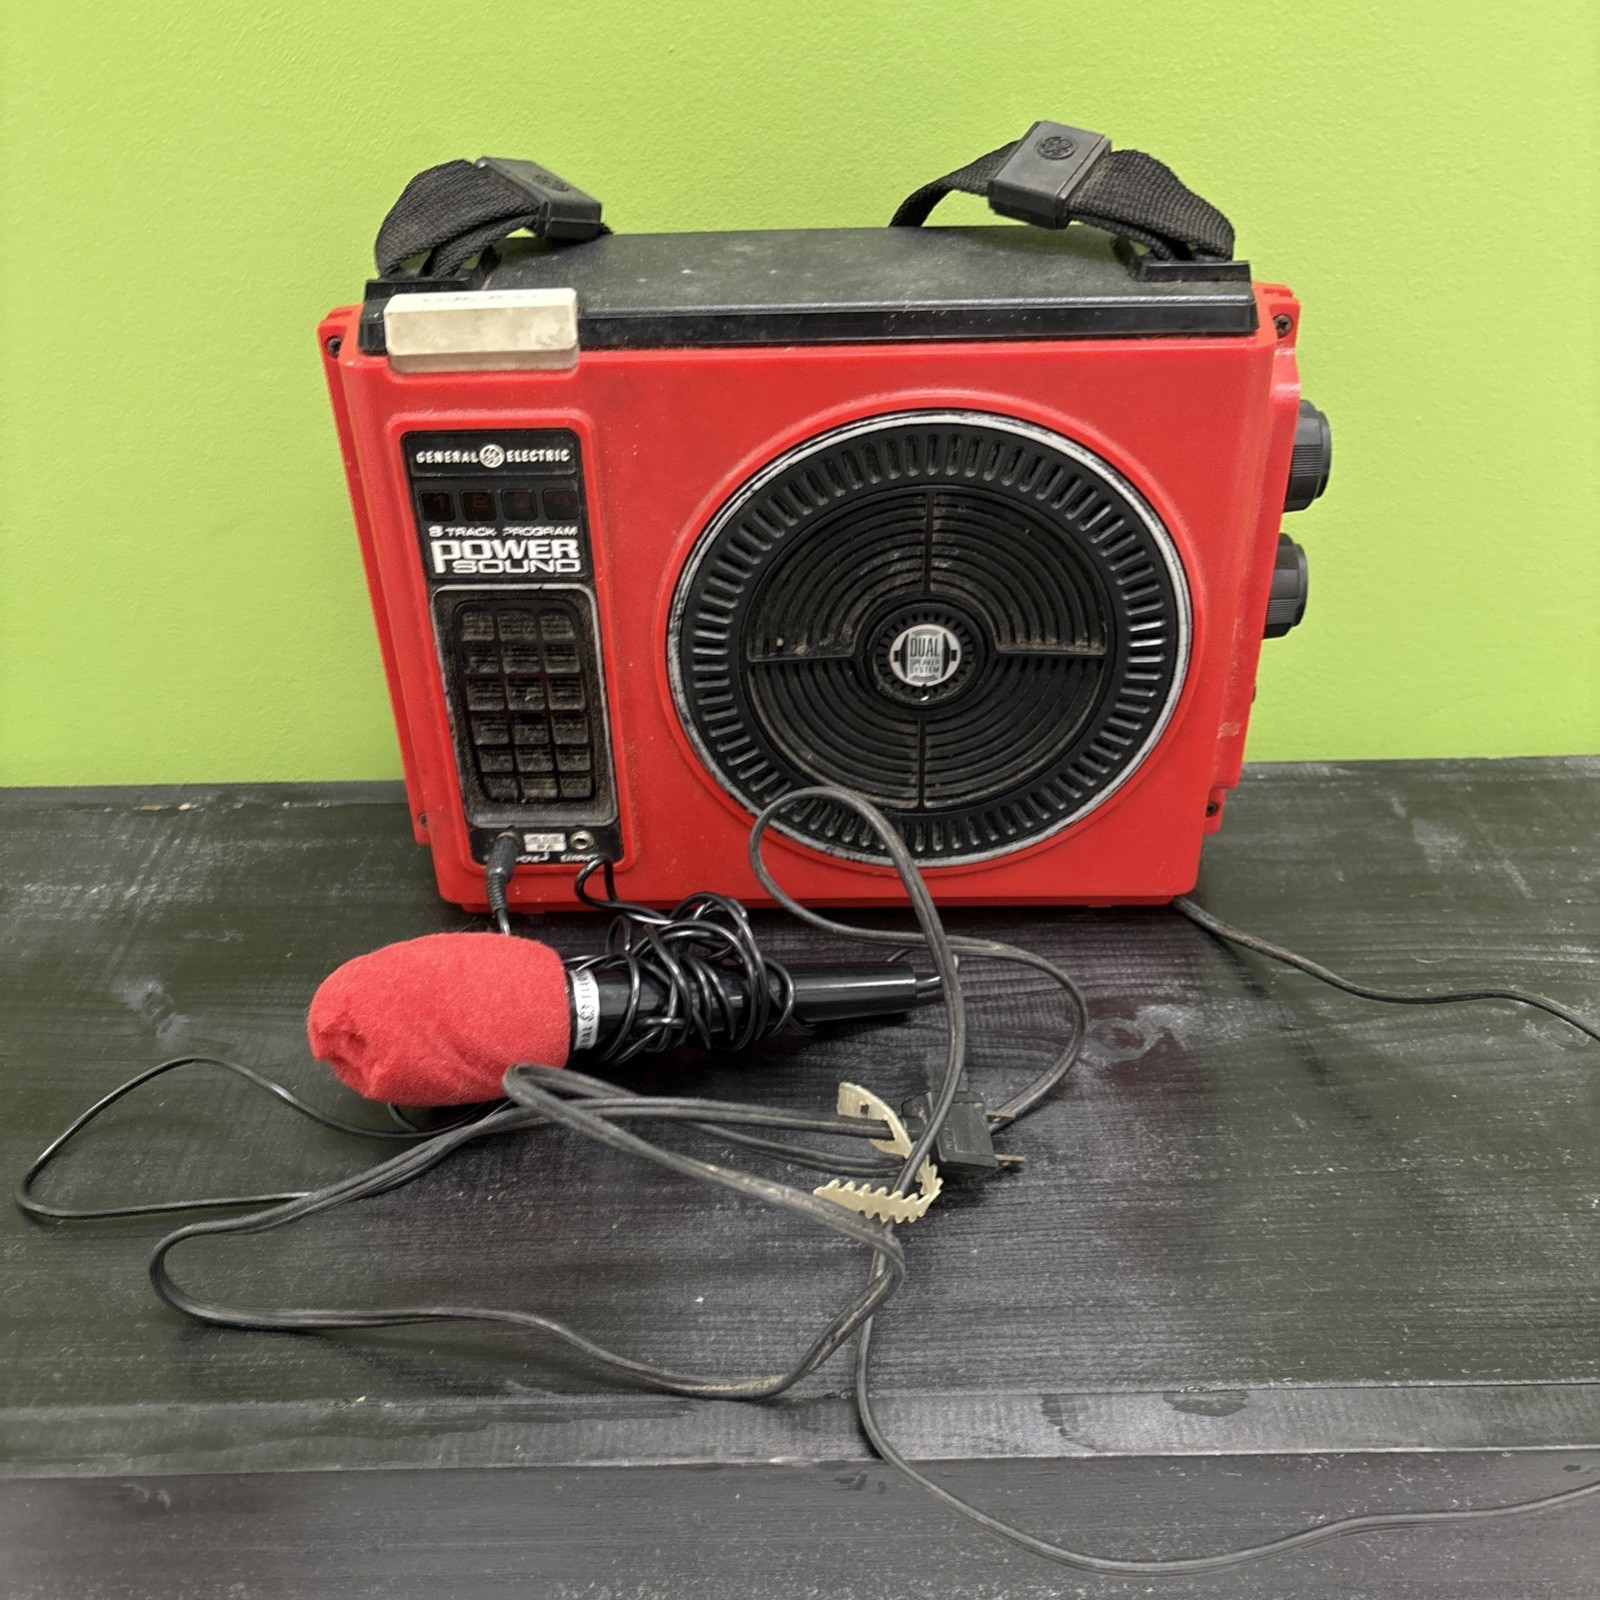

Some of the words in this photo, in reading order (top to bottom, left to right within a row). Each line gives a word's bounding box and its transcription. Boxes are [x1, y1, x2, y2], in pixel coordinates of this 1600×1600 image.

[416, 450, 480, 464] GENERAL
[506, 449, 570, 463] ELECTRIC
[428, 526, 444, 538] 8
[445, 527, 497, 537] TRACK
[502, 526, 577, 537] PROGRAM
[431, 539, 580, 574] POWER
[452, 559, 581, 574] SOUND
[911, 639, 940, 657] DUAL
